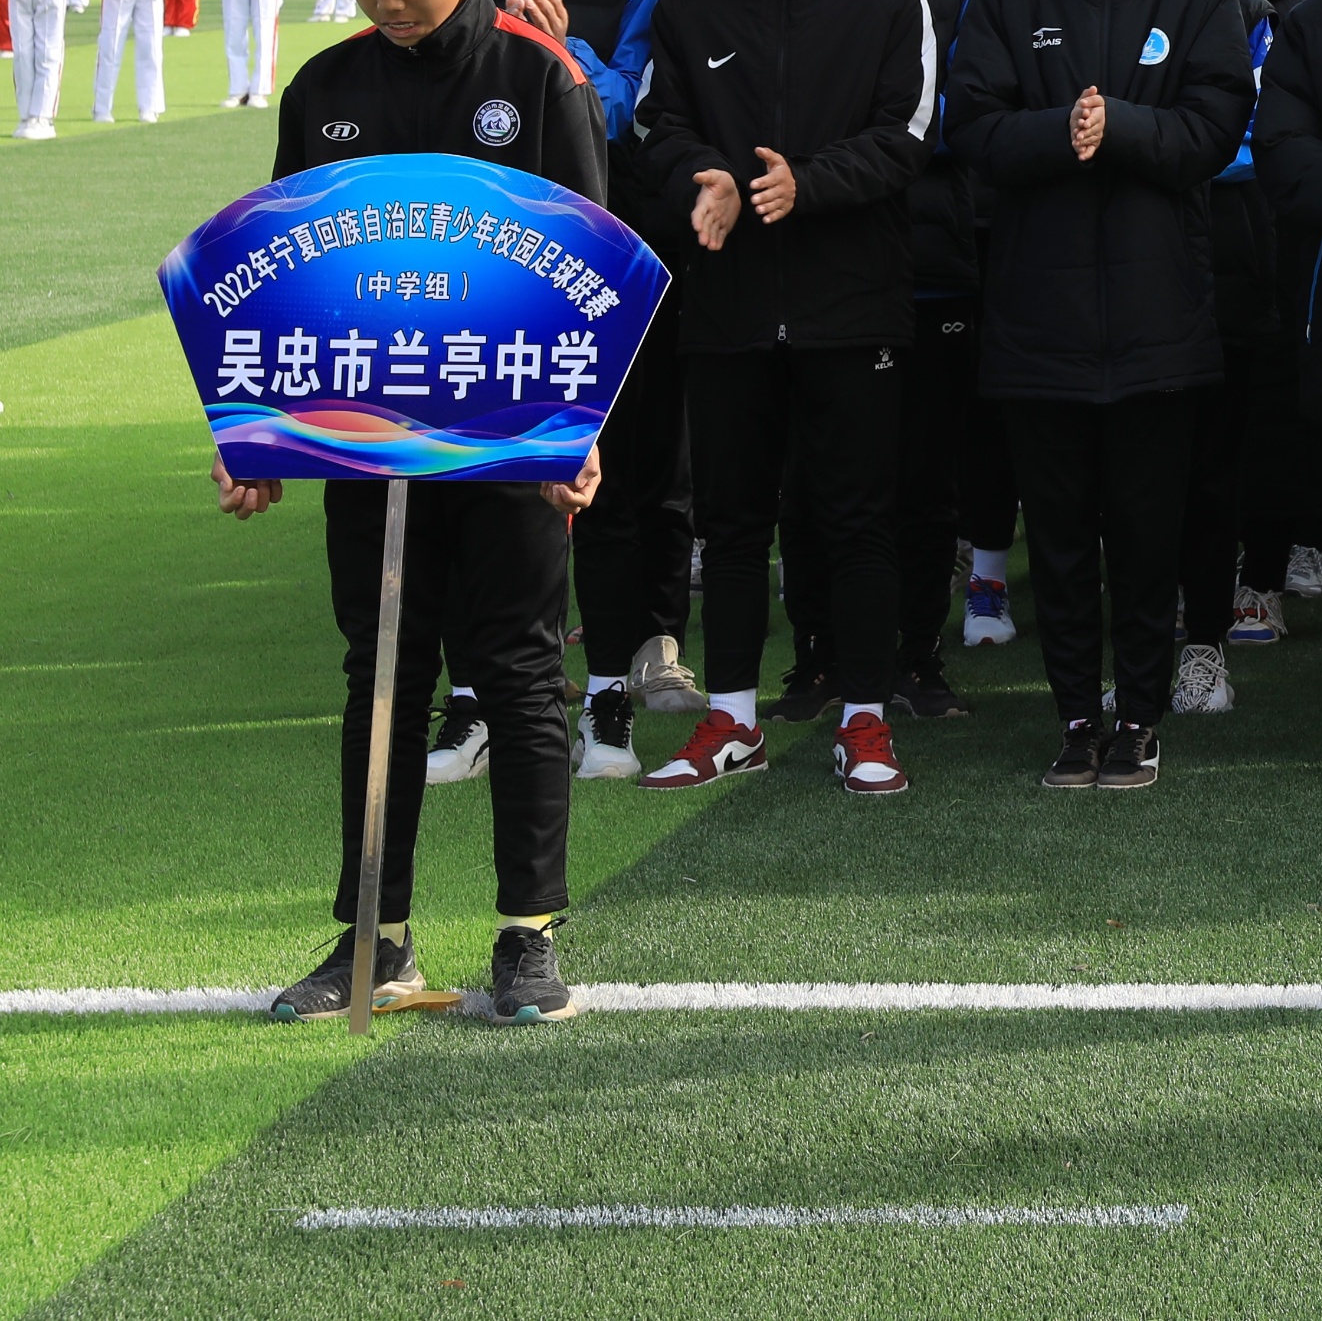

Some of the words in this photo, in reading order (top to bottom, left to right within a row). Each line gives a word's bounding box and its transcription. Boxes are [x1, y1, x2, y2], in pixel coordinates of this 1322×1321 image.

[202, 201, 621, 323] 2022年宁夏回族自治区青少年校园足球联赛
[215, 326, 599, 402] 吴忠市兰亭中学
